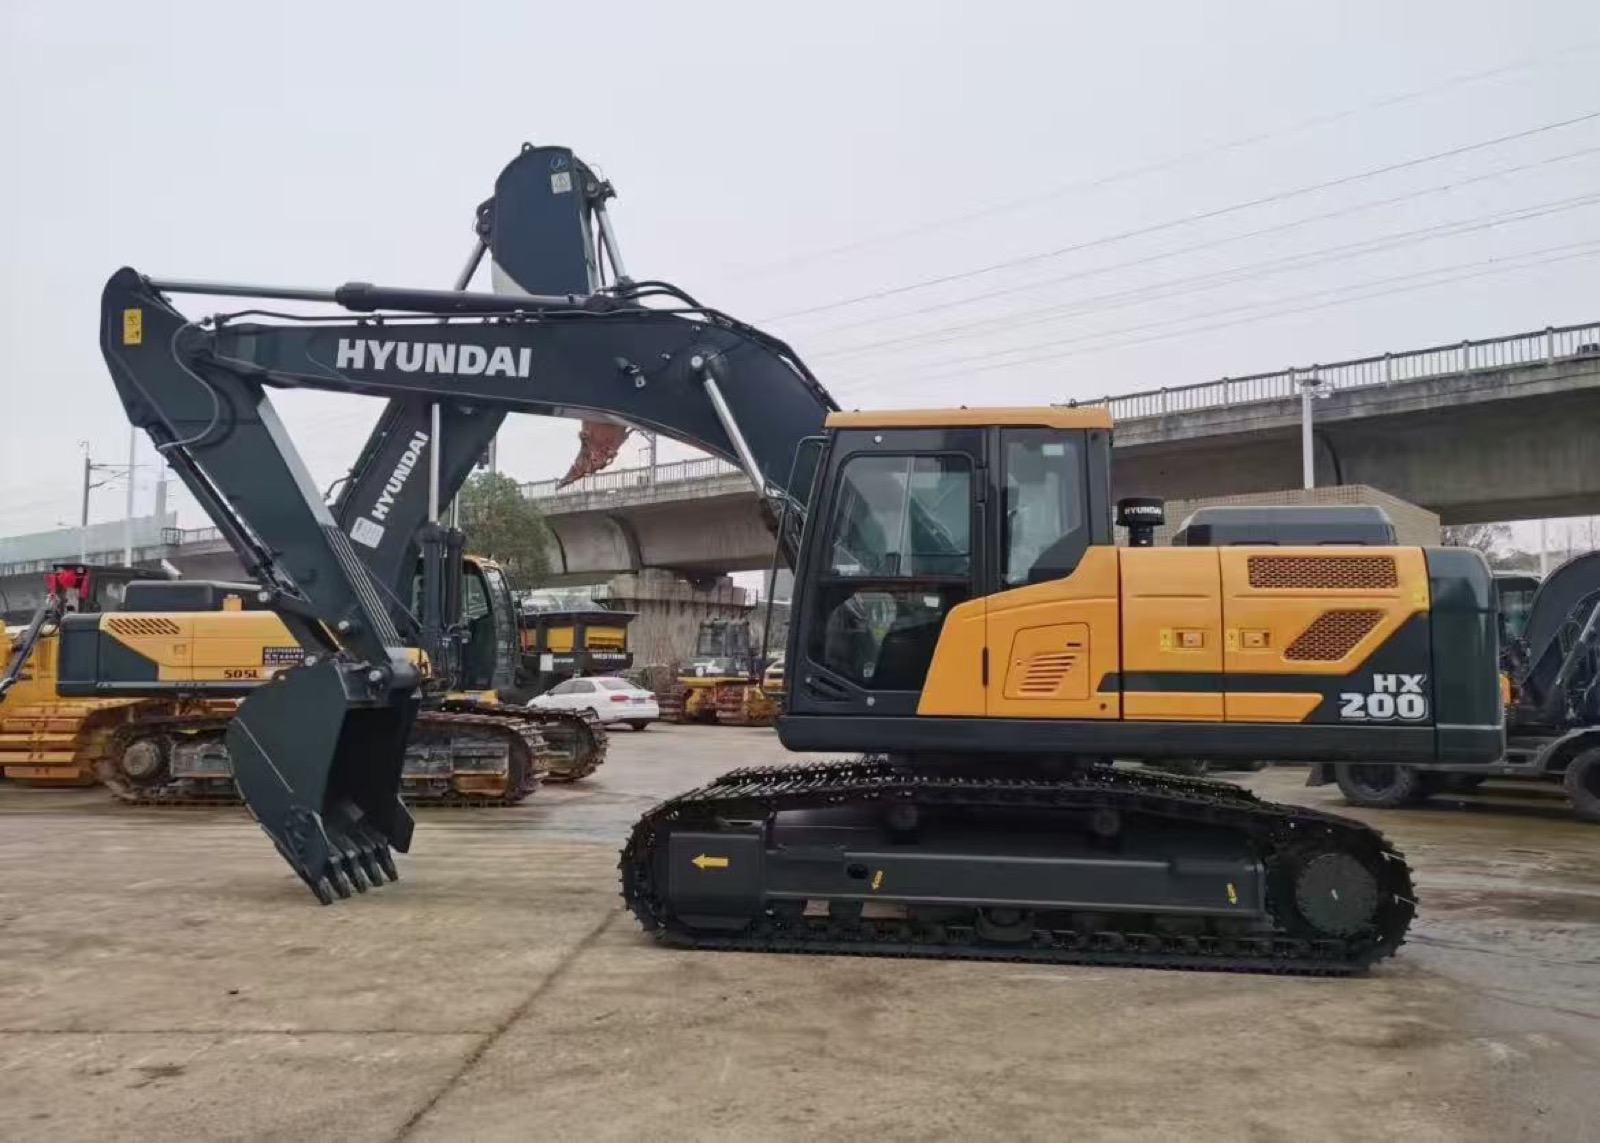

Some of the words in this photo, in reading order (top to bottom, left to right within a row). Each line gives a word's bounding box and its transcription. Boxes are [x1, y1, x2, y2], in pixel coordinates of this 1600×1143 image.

[336, 339, 532, 378] HYUNDAI
[371, 431, 429, 521] HYUNDAI
[223, 669, 260, 679] 505L
[1373, 673, 1424, 693] HX
[1340, 692, 1425, 718] 200
